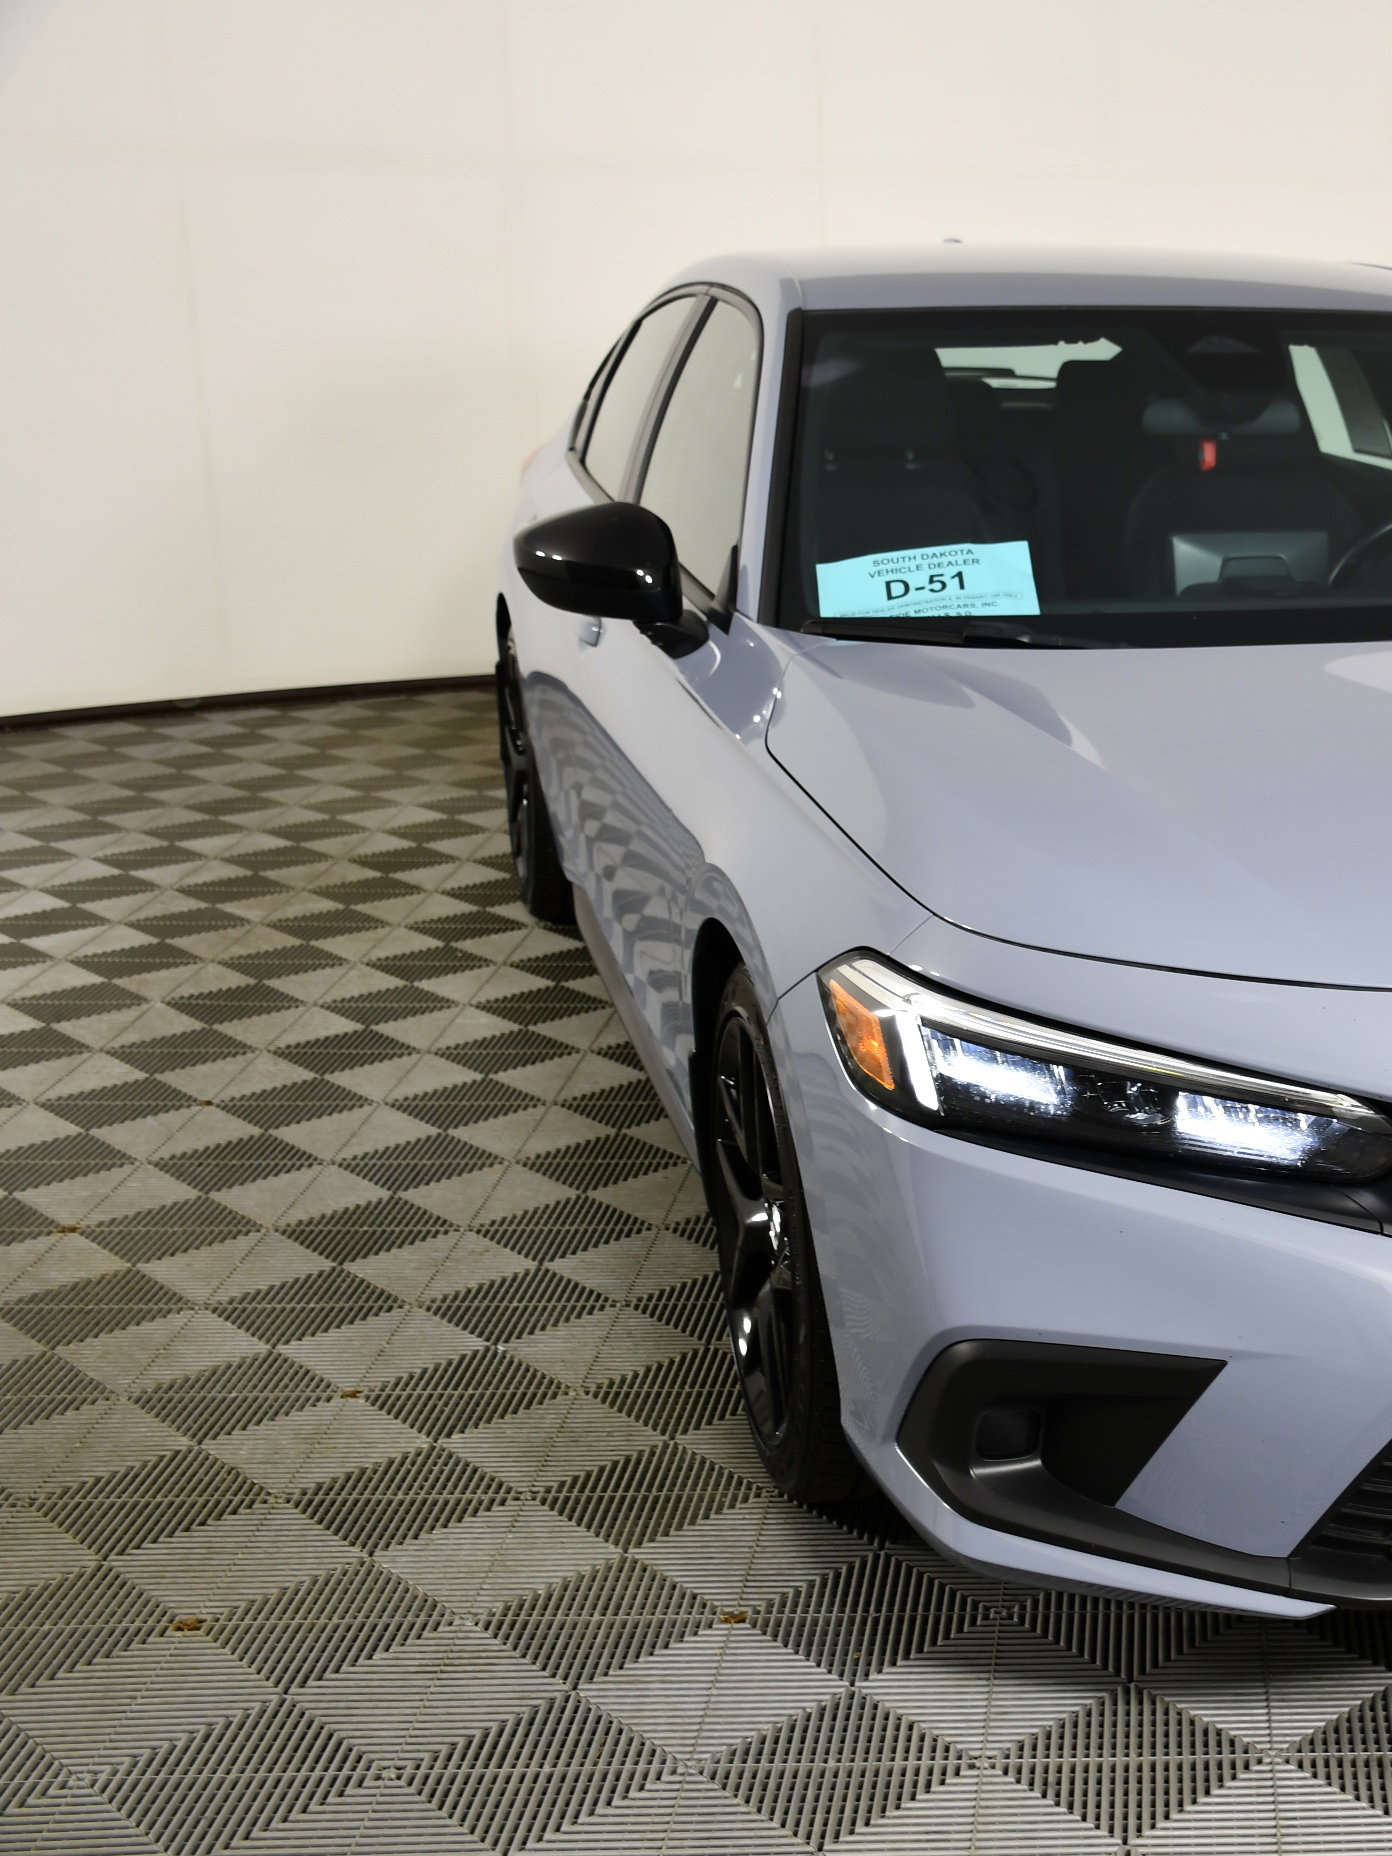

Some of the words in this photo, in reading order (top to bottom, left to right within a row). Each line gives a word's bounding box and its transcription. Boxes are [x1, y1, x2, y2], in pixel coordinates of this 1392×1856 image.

[868, 564, 924, 579] VEHICLE
[928, 558, 981, 570] DEALER
[872, 554, 917, 567] SOUTH
[921, 549, 974, 560] DAKOTA
[884, 571, 965, 601] D-51
